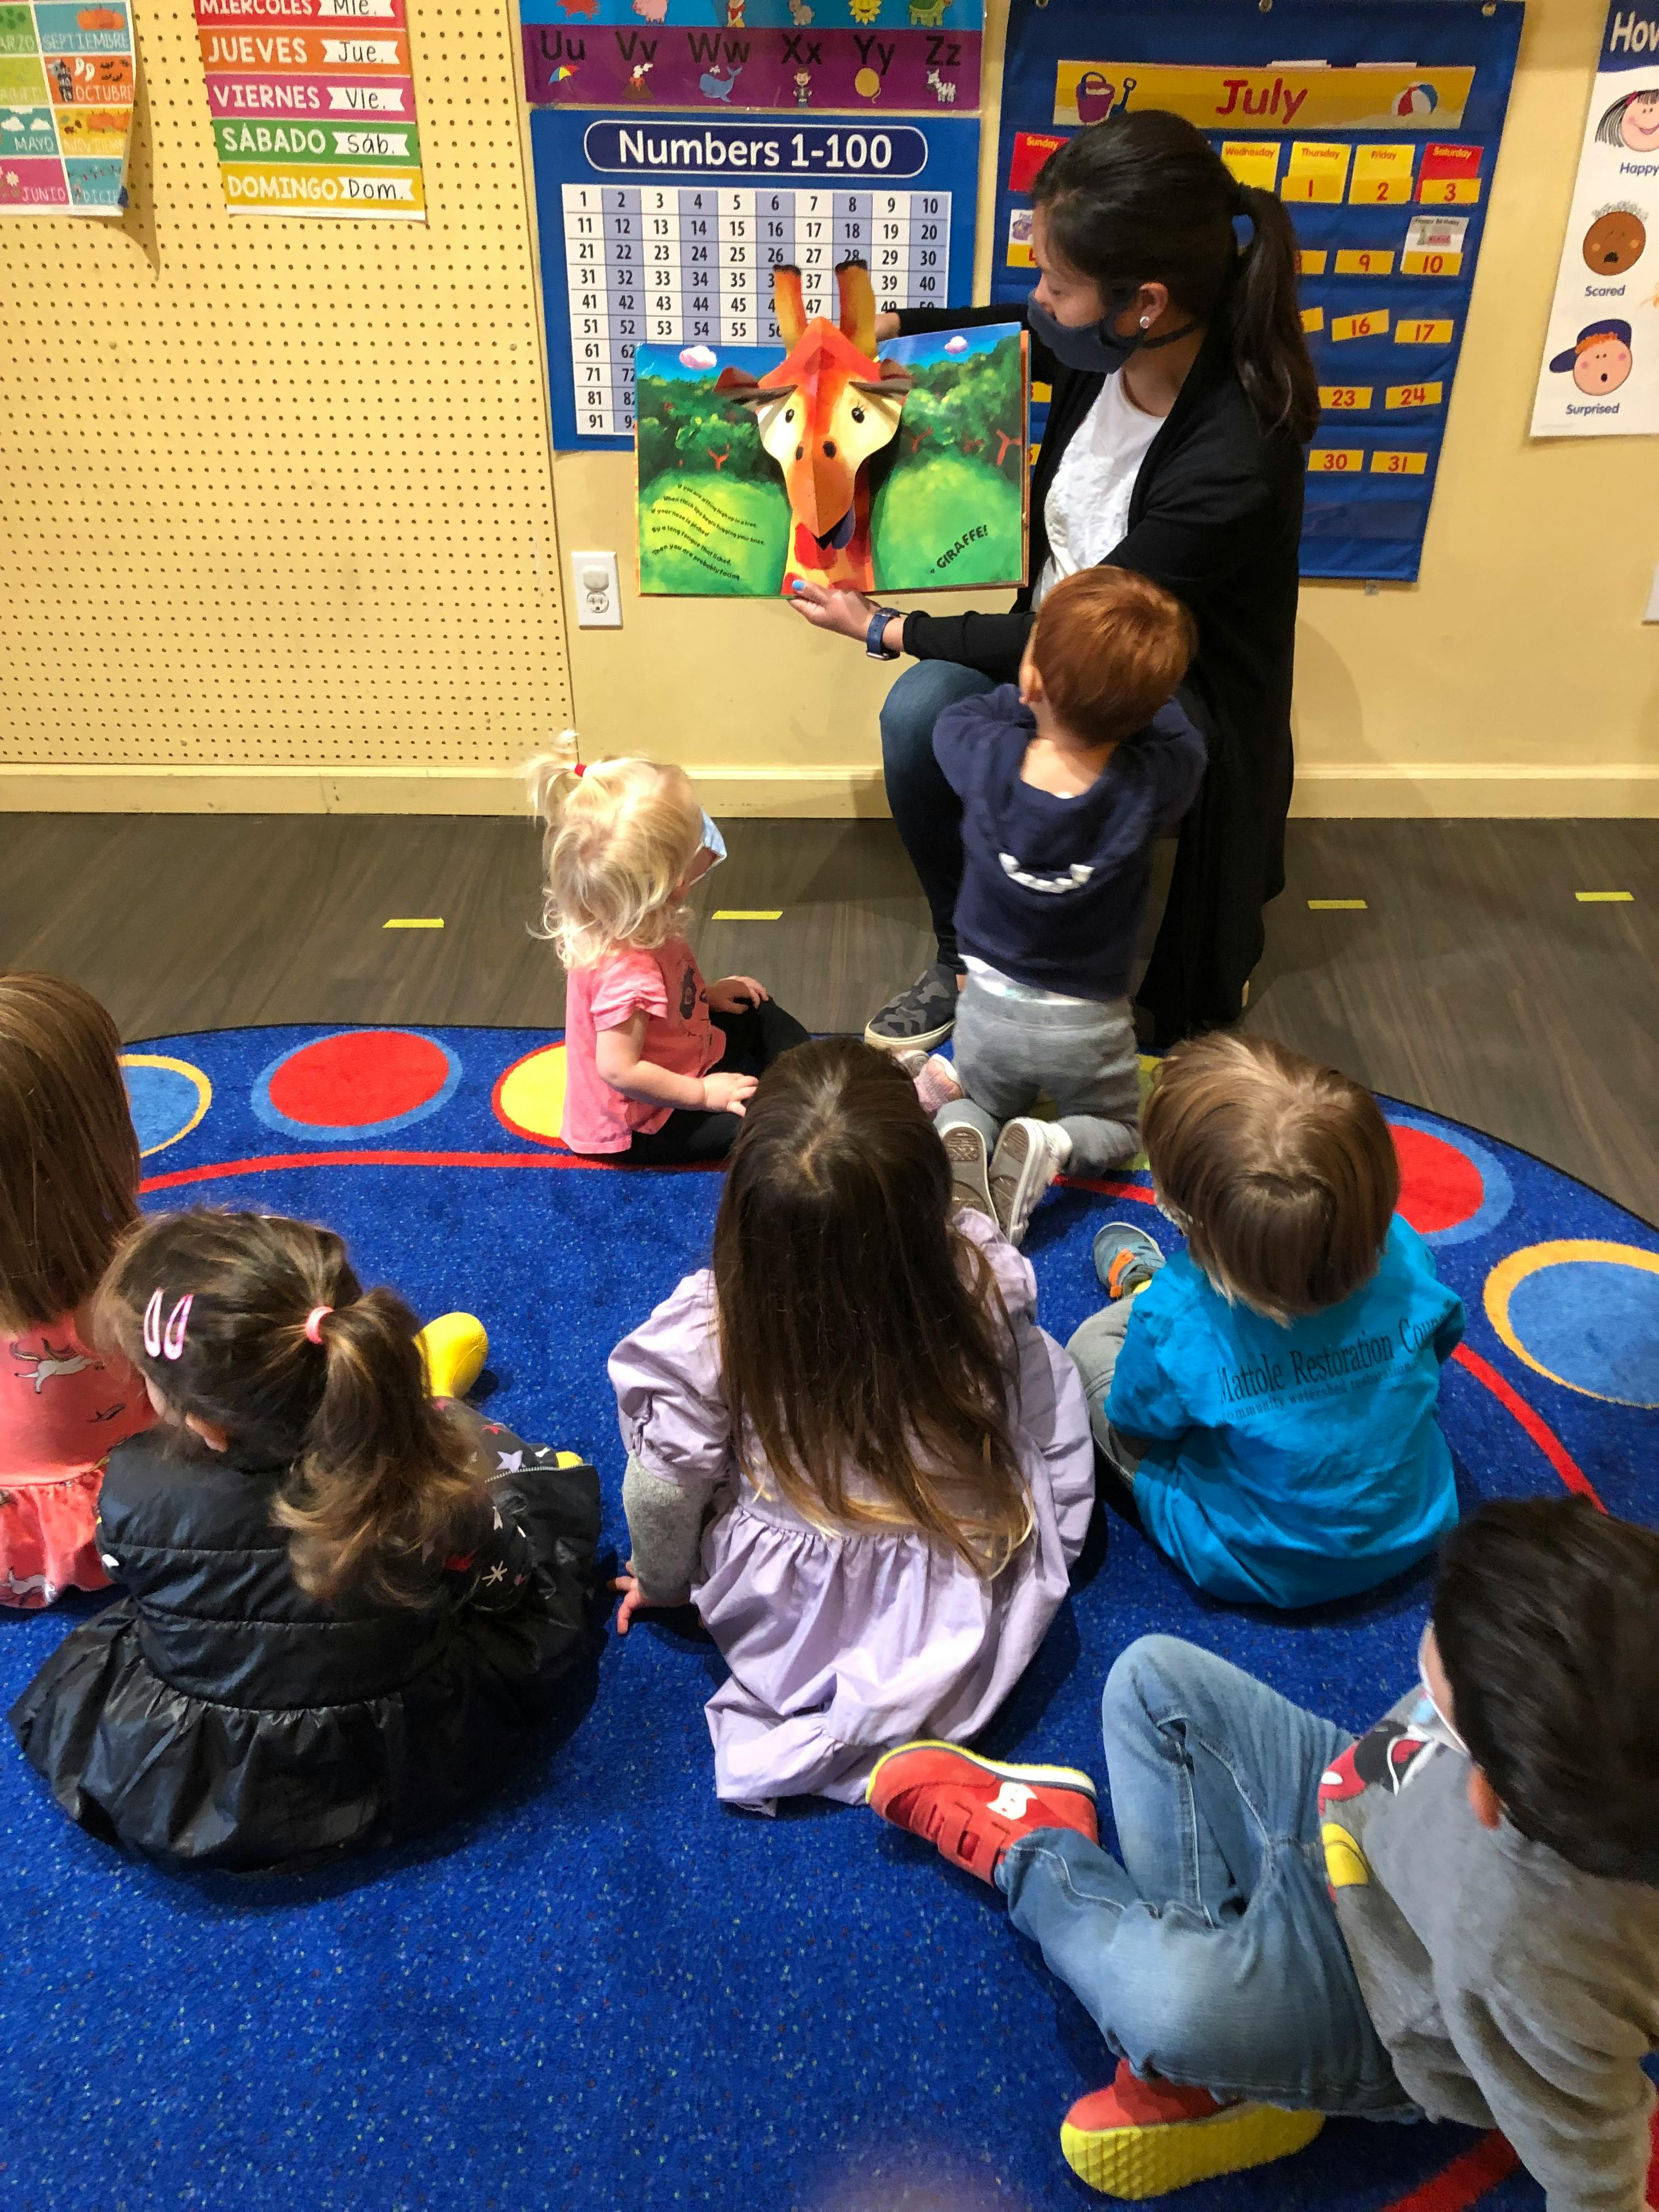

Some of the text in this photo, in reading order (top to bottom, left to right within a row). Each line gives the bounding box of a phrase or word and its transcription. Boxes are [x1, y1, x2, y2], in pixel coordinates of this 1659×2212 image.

[208, 35, 383, 63] JUEVES Jue.
[540, 30, 961, 76] Uu Vv Ww Xx Yy Zz
[76, 84, 133, 101] OCTUBRE
[213, 84, 321, 109] VIERNES
[1215, 78, 1308, 125] July
[14, 136, 54, 153] MAYO
[222, 123, 394, 154] SÁBADO Sáb.
[619, 129, 893, 169] Numbers 1-100
[1026, 136, 1472, 160] Sunday Wednesday Thursday Friday Saturday
[1620, 162, 1659, 177] Happy
[22, 187, 66, 202] JUNIO
[227, 175, 404, 201] DOMINGO Dom.
[1308, 179, 1457, 202] 1 2 3
[580, 191, 938, 214] 1 2 3 4 5 6 7 8 9 10
[578, 217, 938, 240] 11 12 13 14 15 16 17 18 19 20
[579, 243, 936, 266] 21 22 23 24 25 26 27 28 29 30
[1359, 254, 1443, 273] 9 10
[580, 269, 935, 291] 31 32 33 34 35 3 37 39 40
[1584, 284, 1626, 297] Scared
[582, 294, 597, 309] 41
[618, 295, 634, 310] 42
[656, 296, 672, 311] 43
[693, 297, 709, 311] 44
[730, 297, 746, 312] 45
[768, 298, 775, 313] 4
[805, 298, 822, 314] 47
[584, 319, 597, 334] 51
[620, 320, 635, 335] 52
[657, 320, 672, 335] 53
[694, 321, 709, 336] 54
[732, 322, 747, 337] 55
[1352, 316, 1435, 341] 16 17
[585, 343, 635, 359] 61 62
[586, 367, 600, 381] 71
[588, 391, 602, 405] 81
[1332, 387, 1426, 407] 23 24
[1565, 403, 1620, 416] Surprised
[589, 414, 603, 428] 91
[1323, 454, 1409, 472] 30 31
[672, 511, 686, 521] nose
[667, 524, 681, 536] long
[681, 531, 701, 548] tongue
[701, 545, 713, 557] that
[936, 524, 988, 568] GIRAFFE!
[652, 544, 668, 555] Then
[682, 549, 693, 557] are
[692, 556, 720, 574] probably
[1289, 1329, 1395, 1386] Restoration
